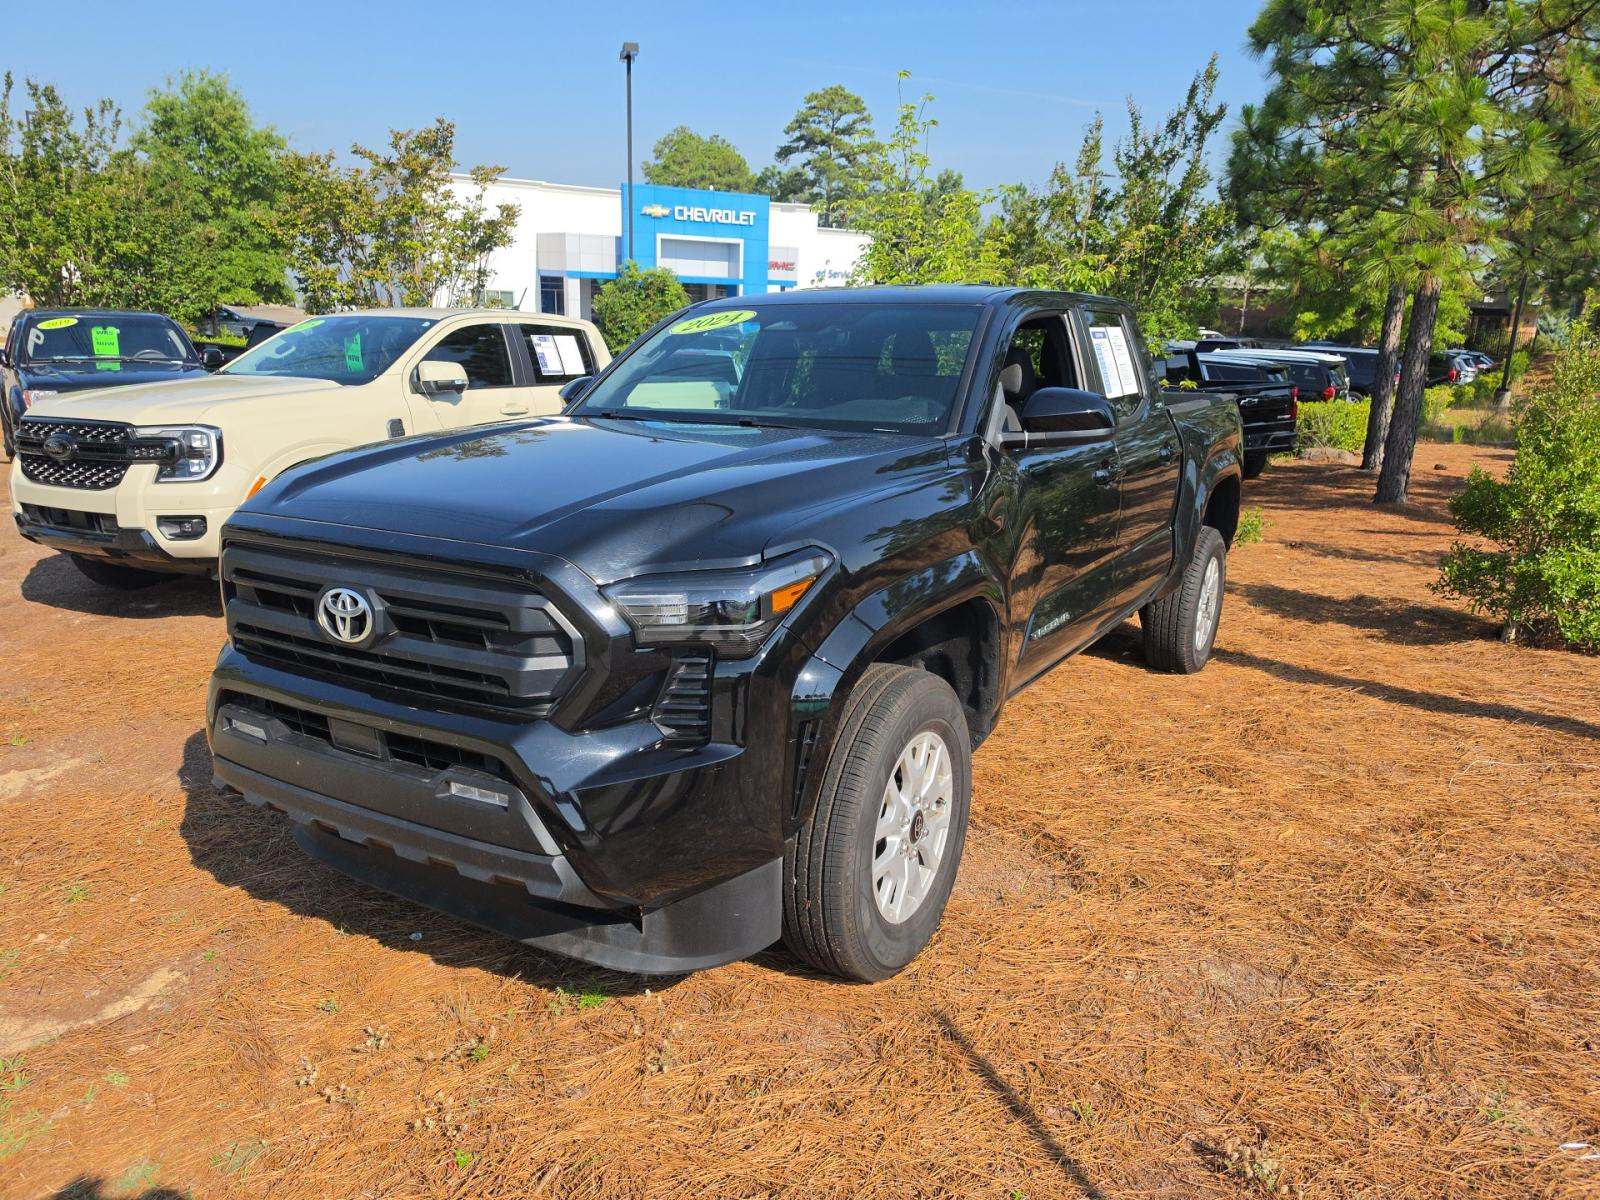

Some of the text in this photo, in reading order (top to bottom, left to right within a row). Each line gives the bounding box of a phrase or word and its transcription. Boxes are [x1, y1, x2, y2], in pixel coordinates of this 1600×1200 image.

[674, 205, 757, 225] CHEVROLET
[768, 260, 796, 271] MC
[681, 312, 745, 331] 2024
